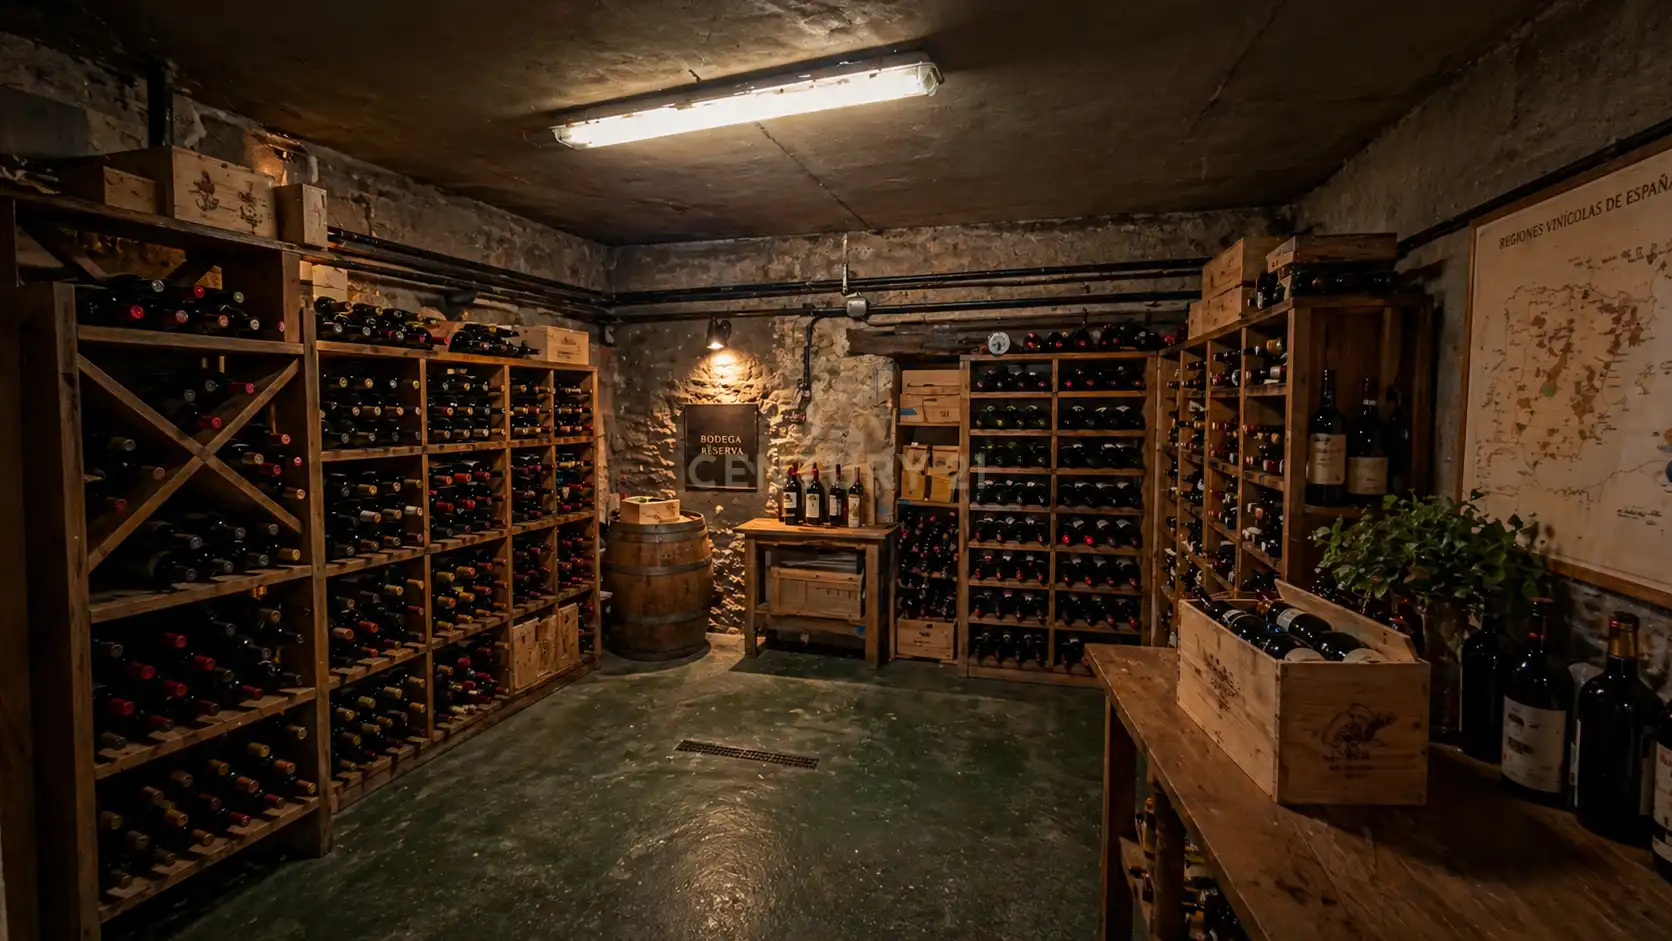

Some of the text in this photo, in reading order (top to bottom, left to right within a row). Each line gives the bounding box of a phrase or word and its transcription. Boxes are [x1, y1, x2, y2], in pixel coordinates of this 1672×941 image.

[1499, 223, 1544, 250] REGIONES
[1546, 201, 1602, 233] VINÍCOLAS
[1606, 193, 1622, 212] DE
[700, 435, 742, 444] BODEGA
